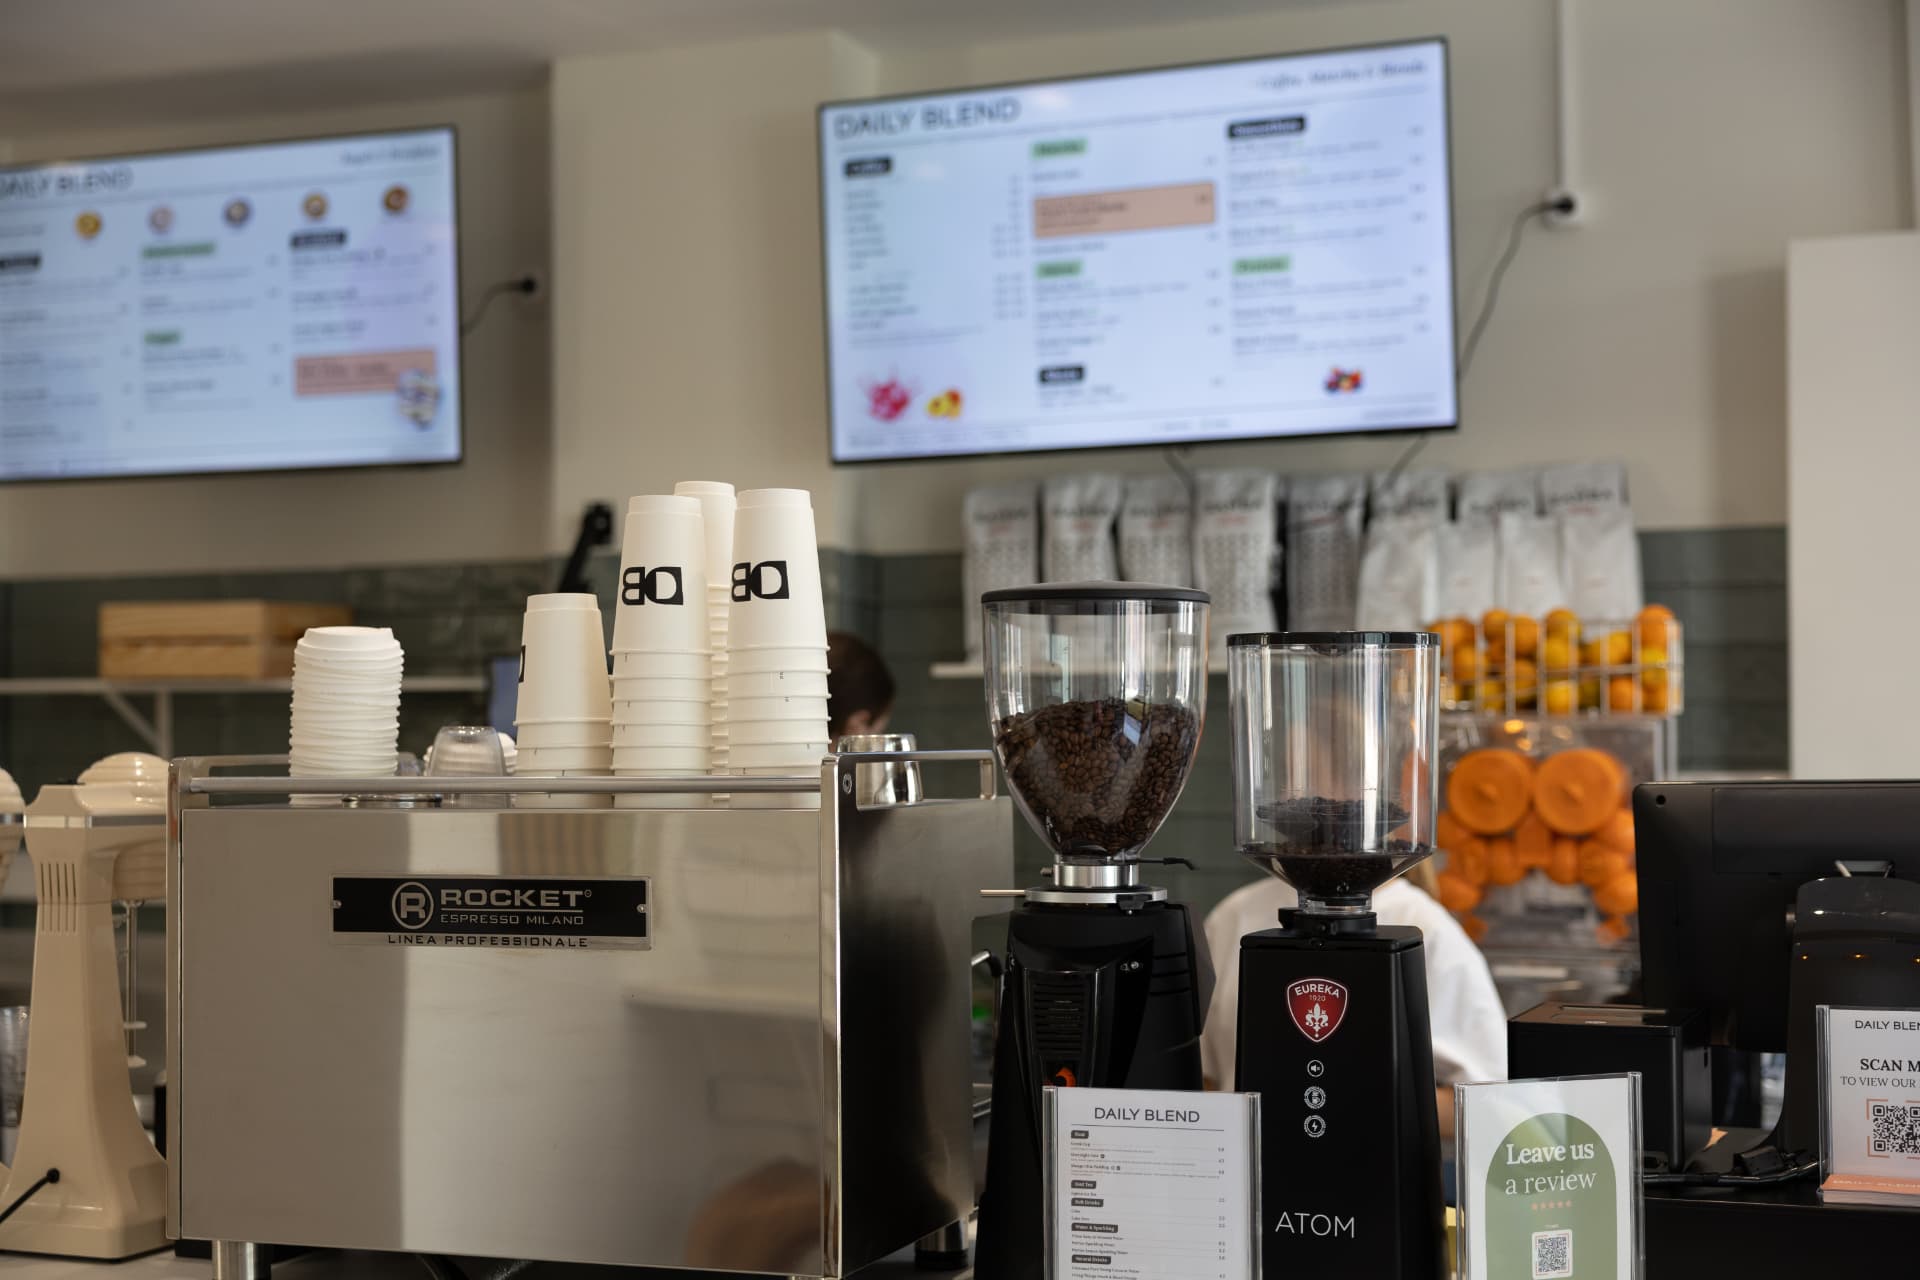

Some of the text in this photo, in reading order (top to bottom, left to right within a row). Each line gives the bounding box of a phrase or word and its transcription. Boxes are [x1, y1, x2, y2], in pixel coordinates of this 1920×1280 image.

[833, 96, 1023, 140] DAILY BLEND
[440, 914, 584, 926] ESPRESSO MILANO
[388, 935, 589, 948] LINEA PROFESSIONALE
[1294, 983, 1340, 999] EUREKA
[1308, 994, 1326, 1002] 1920
[1854, 1020, 1890, 1030] DAILY
[1860, 1058, 1903, 1072] SCAN
[1839, 1075, 1916, 1088] TO VIEW OUR
[1094, 1107, 1200, 1123] DAILY BLEND
[1505, 1143, 1595, 1165] Leave us
[1505, 1169, 1597, 1195] a review
[1275, 1211, 1355, 1239] ATOM
